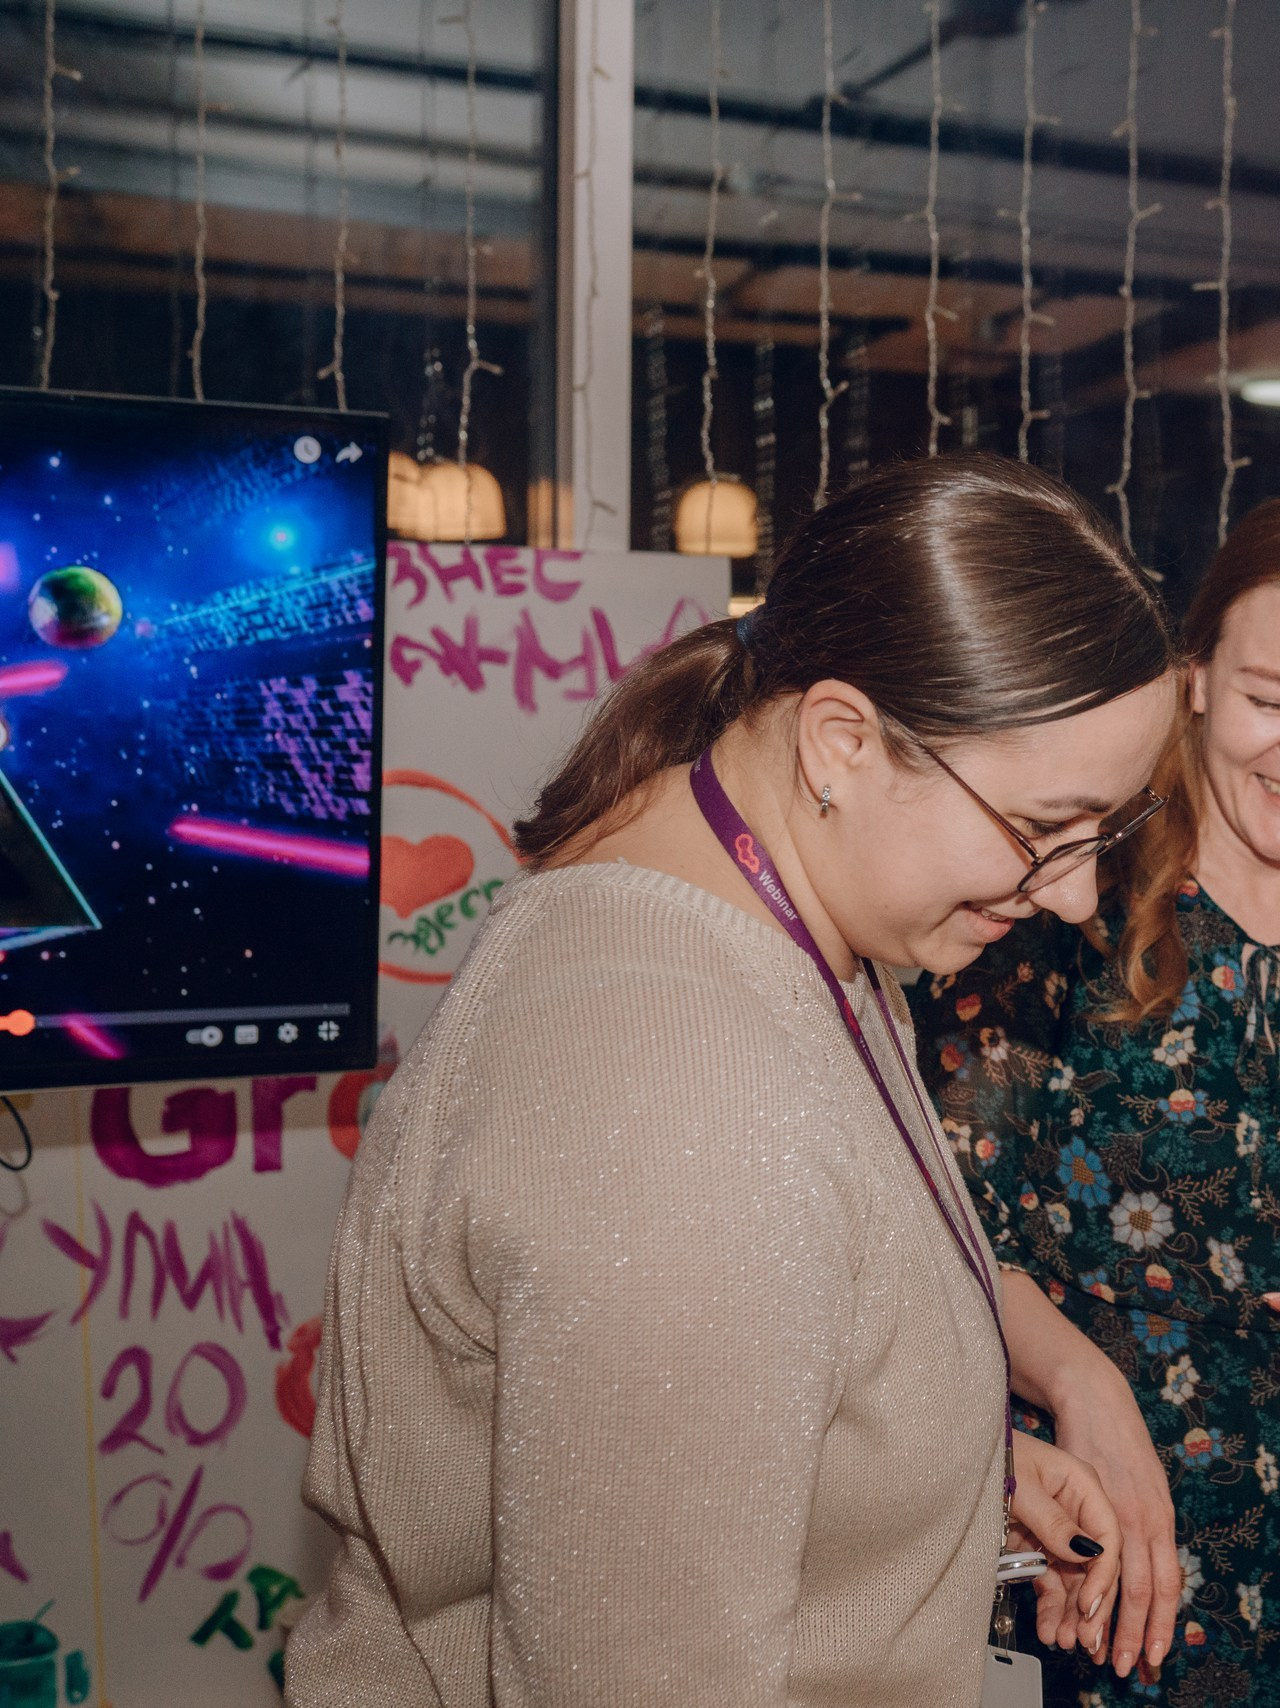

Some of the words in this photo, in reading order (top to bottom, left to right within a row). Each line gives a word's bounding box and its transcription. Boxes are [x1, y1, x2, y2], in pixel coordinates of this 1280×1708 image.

[758, 869, 799, 923] Webinar
[98, 1342, 247, 1456] 20
[103, 1464, 253, 1602] %
